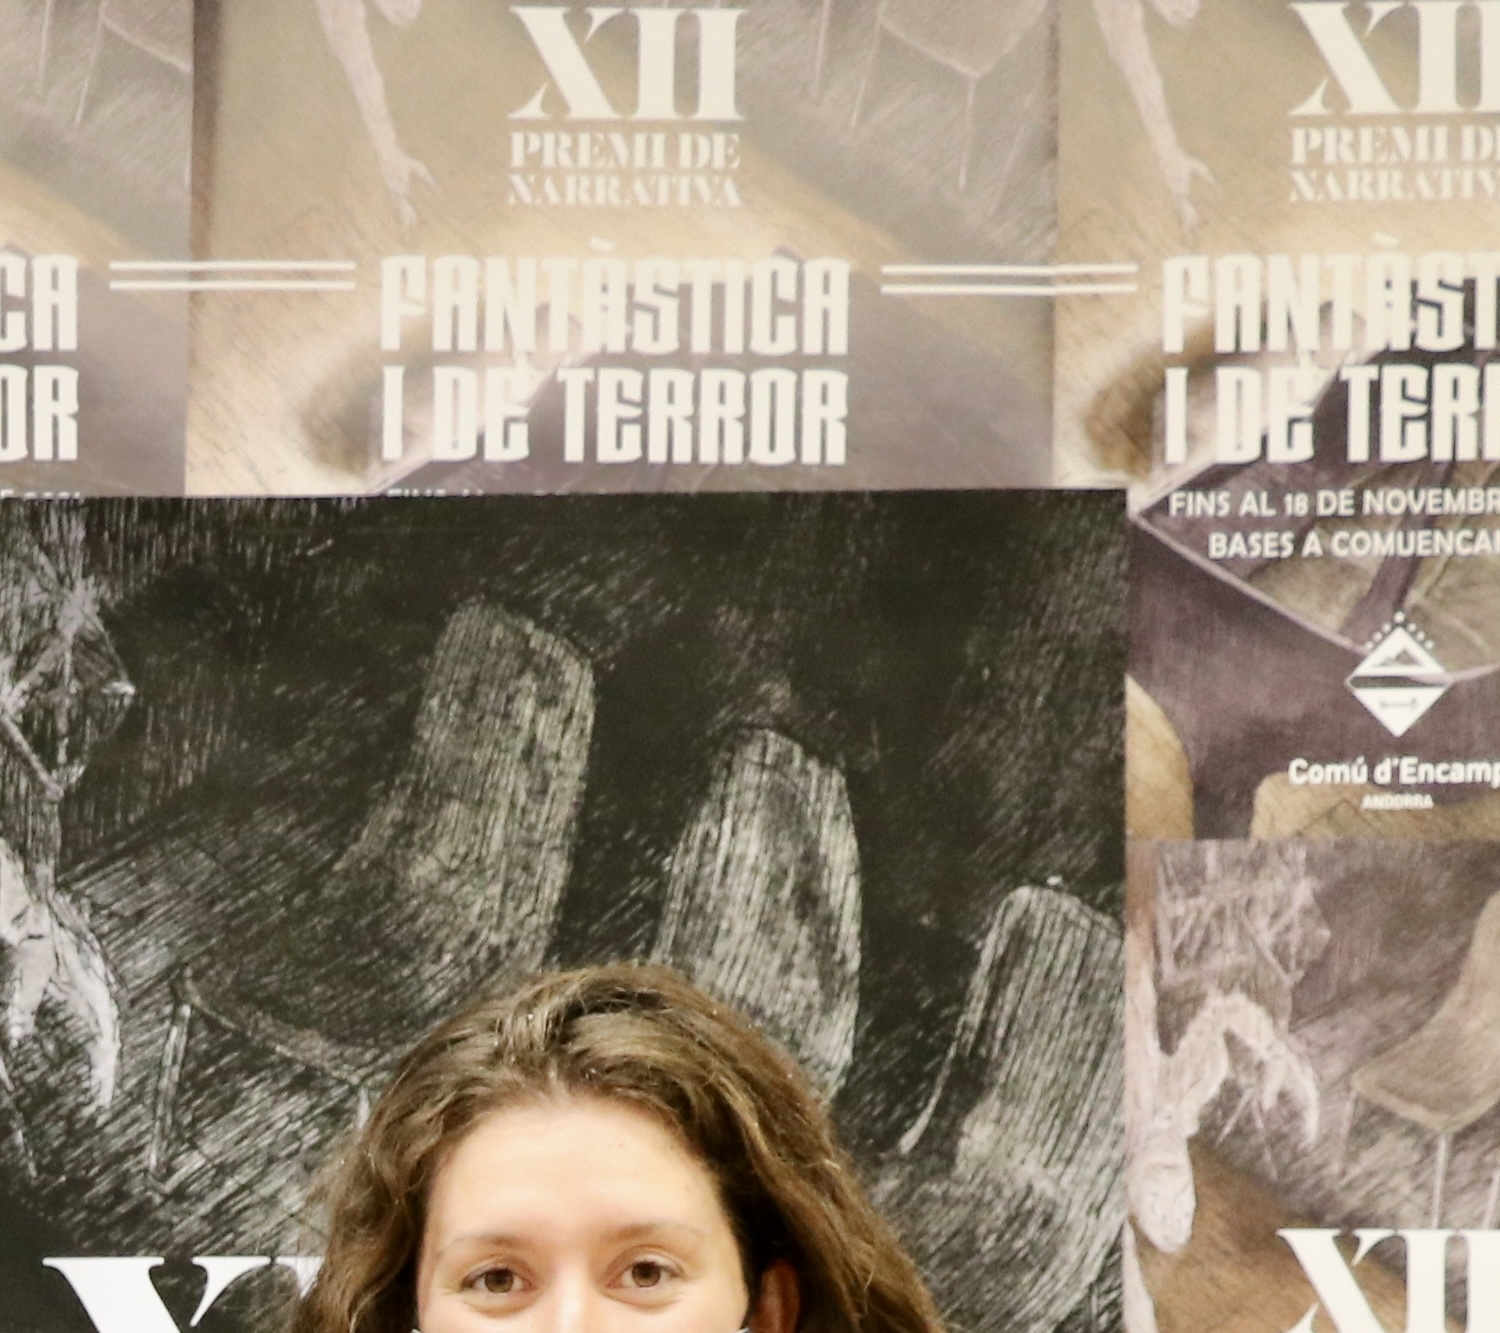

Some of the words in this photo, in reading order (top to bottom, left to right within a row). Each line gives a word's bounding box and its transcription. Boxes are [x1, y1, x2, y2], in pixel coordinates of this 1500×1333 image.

[506, 6, 750, 122] XII
[378, 235, 852, 356] FANTÀSTICA
[380, 366, 408, 462] I
[431, 366, 533, 463] DE
[555, 367, 849, 466] TERROR
[1162, 367, 1190, 465] I
[1214, 365, 1316, 465] DE
[1169, 491, 1230, 519] FINS
[1239, 491, 1277, 518] AL
[1285, 490, 1310, 517] 18
[1318, 489, 1358, 517] DE
[1208, 531, 1295, 560] BASES
[1301, 531, 1325, 558] A
[1289, 758, 1369, 786] Comú
